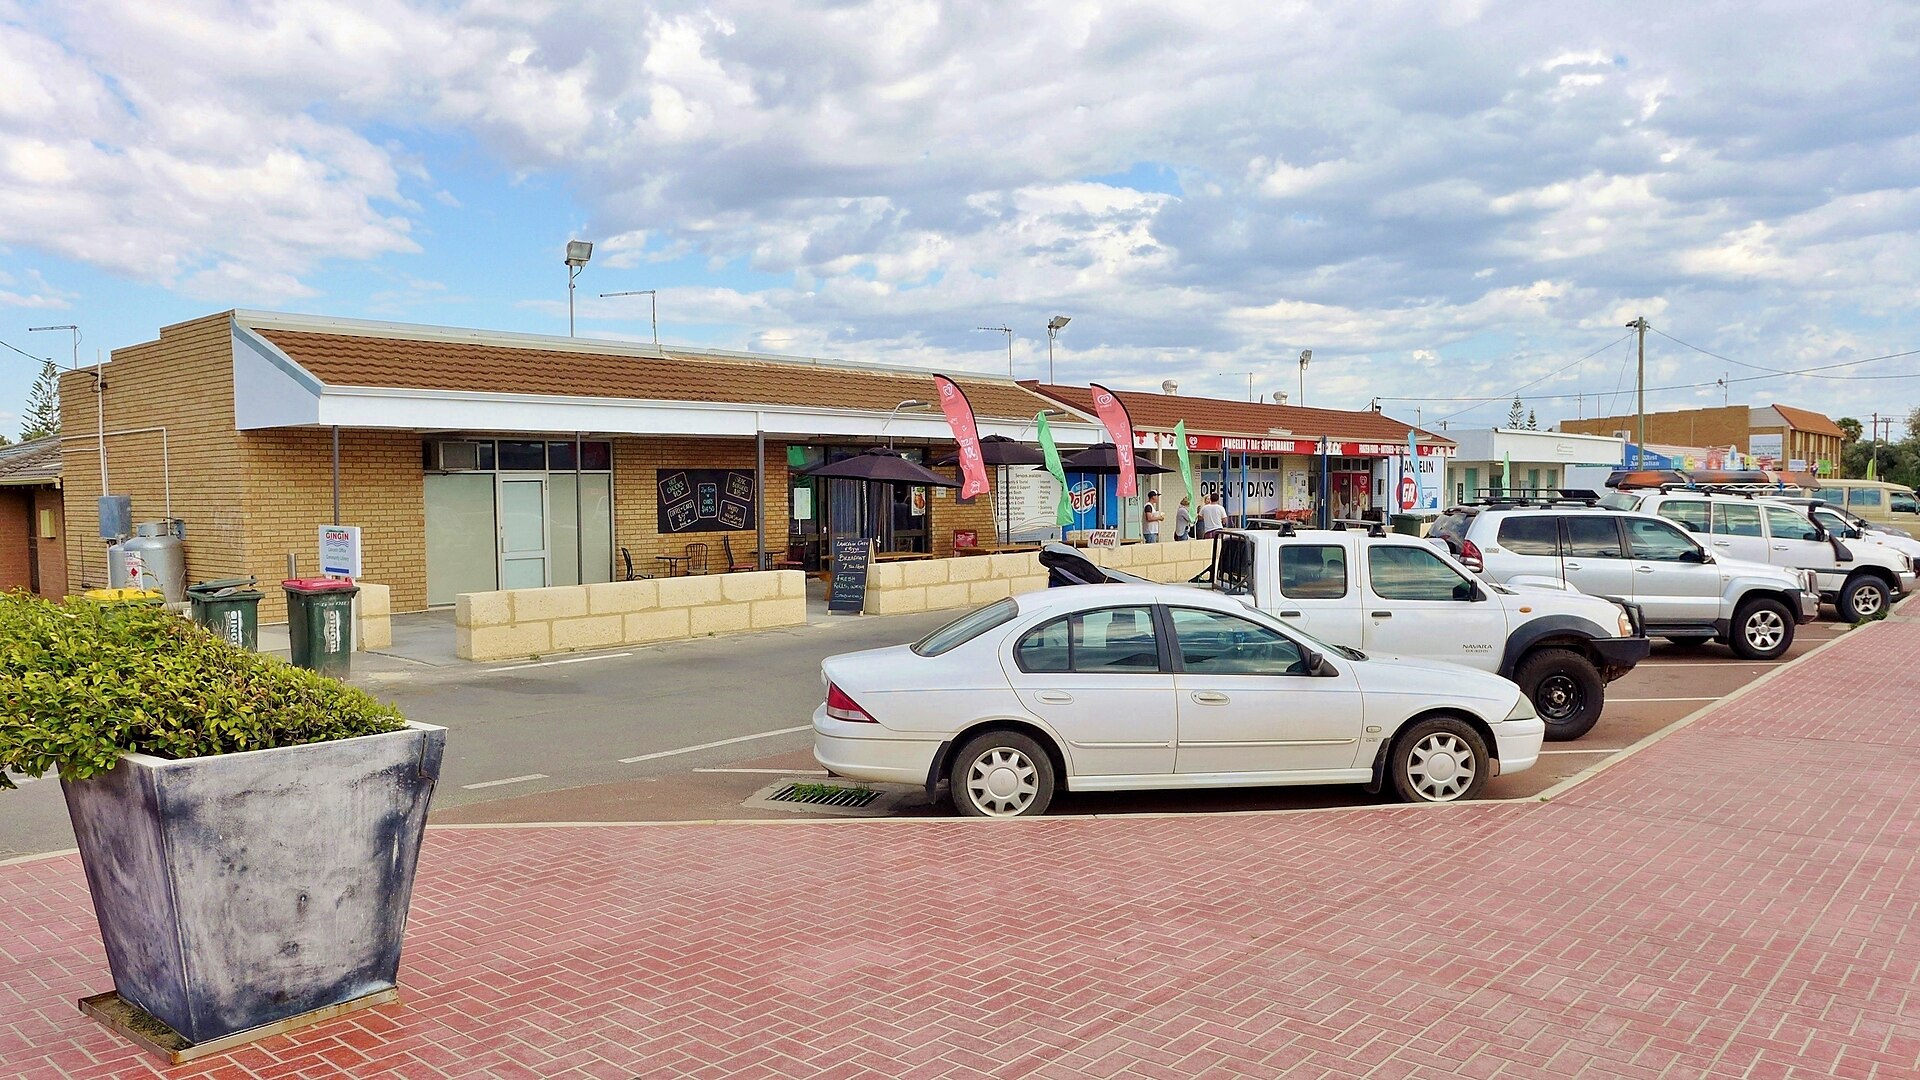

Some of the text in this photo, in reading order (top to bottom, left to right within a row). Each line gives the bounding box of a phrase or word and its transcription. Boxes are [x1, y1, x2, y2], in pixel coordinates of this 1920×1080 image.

[1222, 438, 1247, 450] LANCELIN
[1261, 440, 1295, 452] SUPERMARKET
[1402, 460, 1434, 473] ANELIN
[1248, 482, 1274, 497] DAYS
[325, 532, 349, 540] GINGIN
[1093, 538, 1115, 546] OPEN
[329, 611, 337, 654] GINGIN
